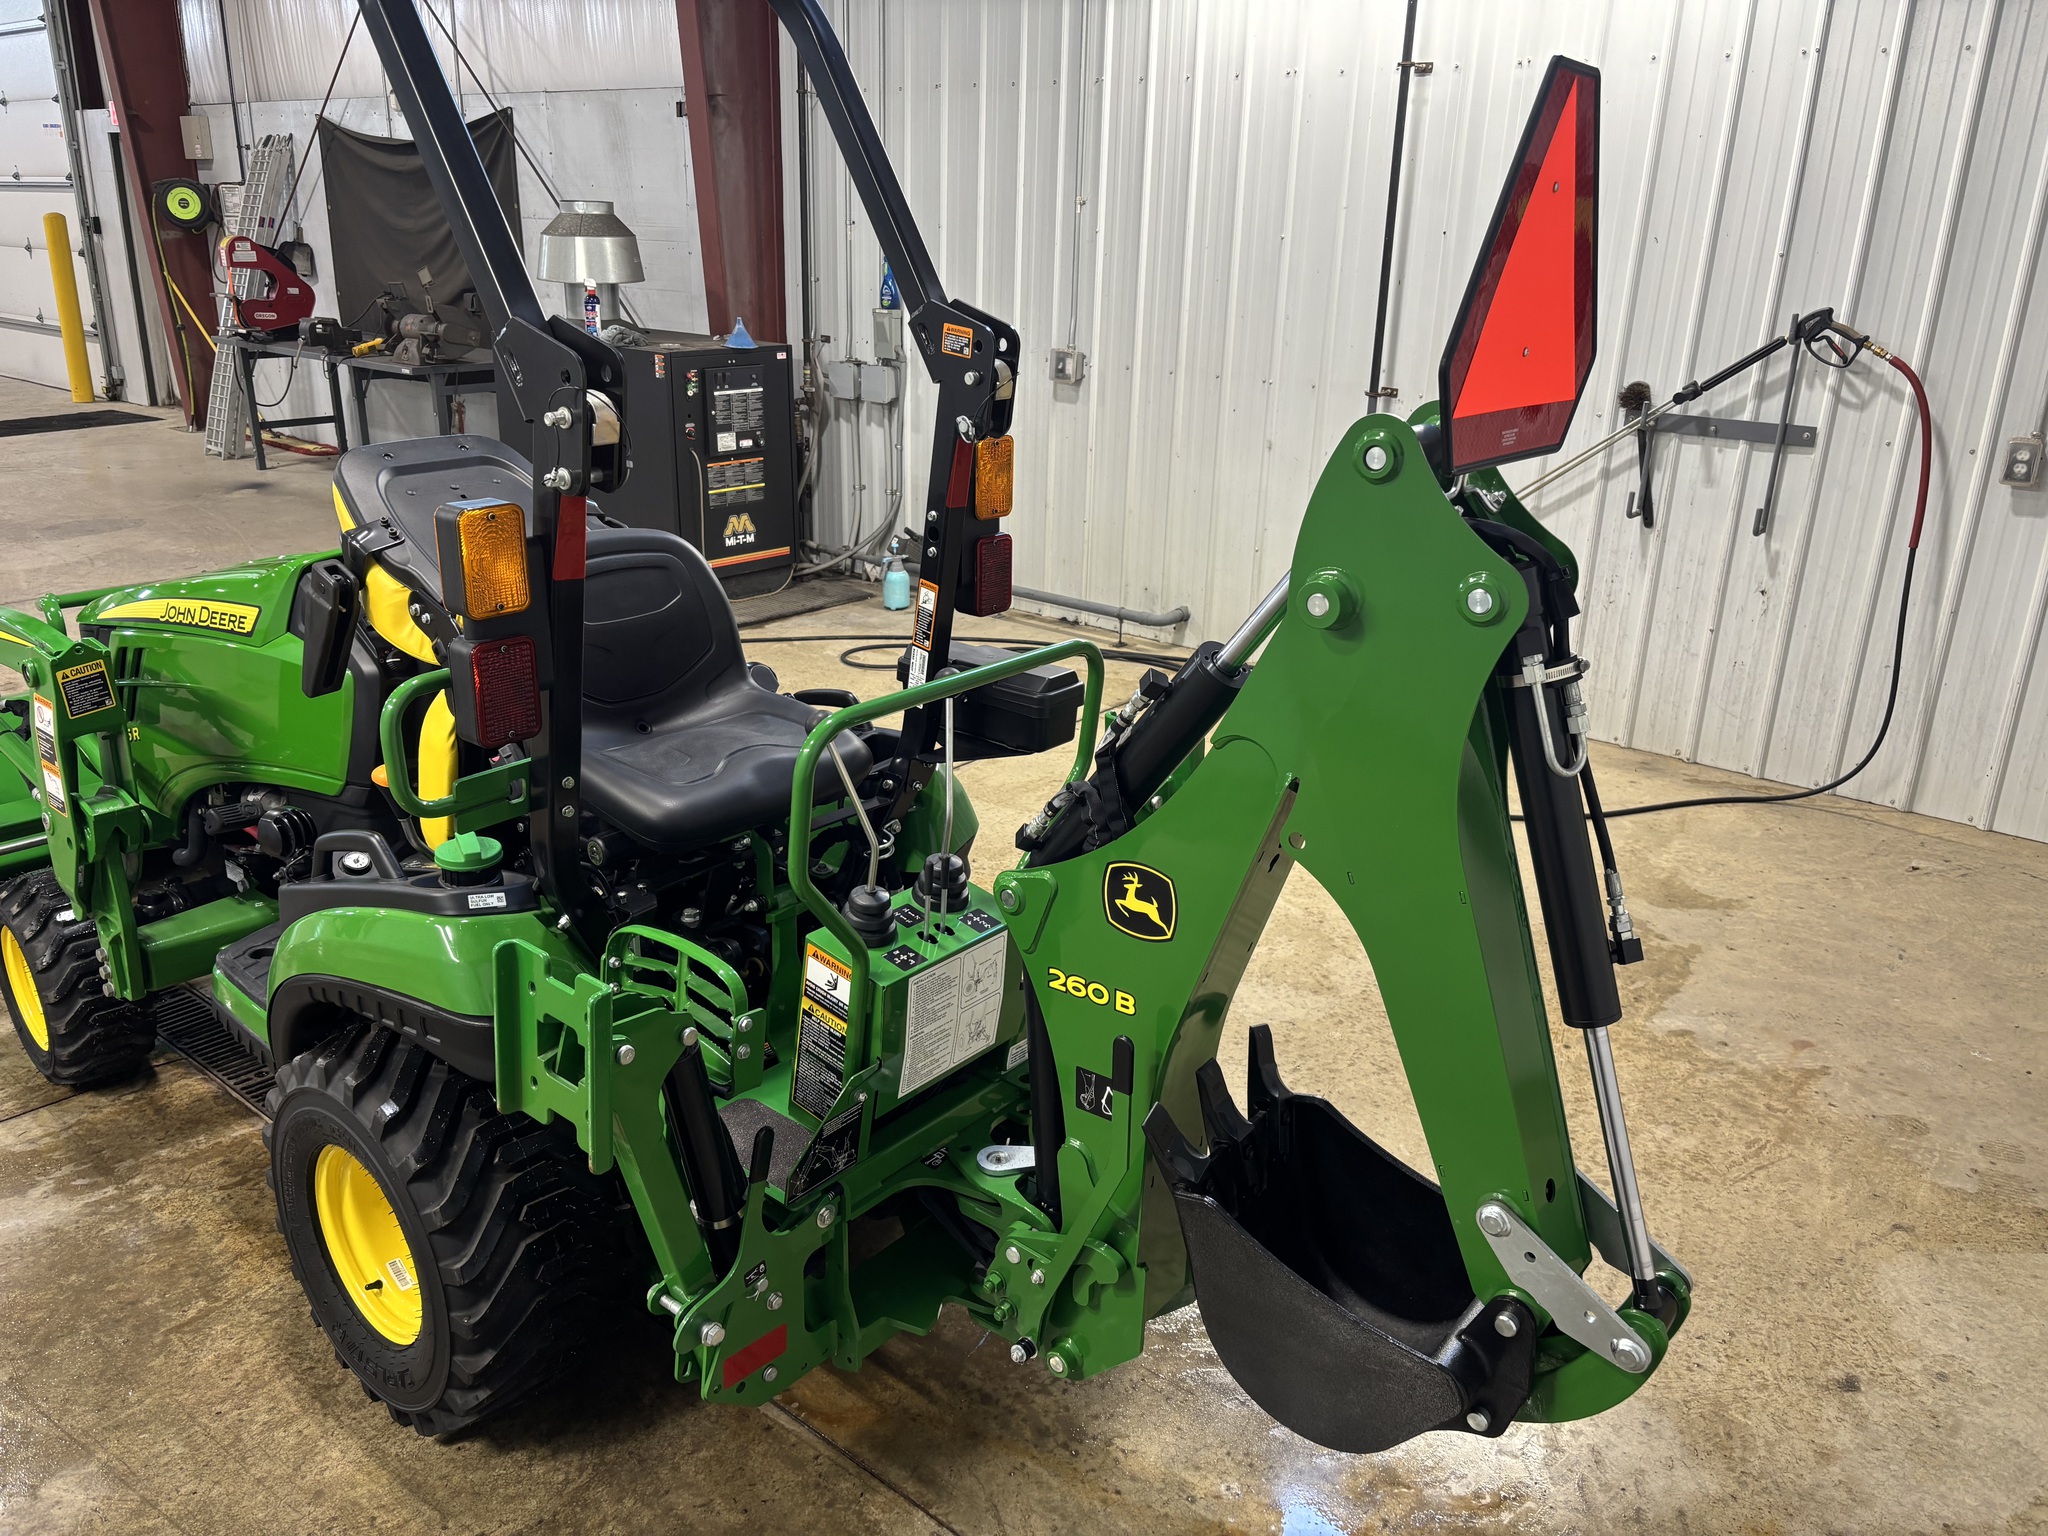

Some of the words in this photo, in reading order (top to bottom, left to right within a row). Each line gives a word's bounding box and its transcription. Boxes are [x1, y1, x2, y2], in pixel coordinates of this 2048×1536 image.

[725, 533, 755, 547] Mi-T-M
[160, 602, 197, 621] JOHN
[199, 606, 248, 630] DEERE
[70, 660, 103, 677] CAUTION
[1048, 967, 1110, 1006] 260
[1114, 988, 1136, 1016] B
